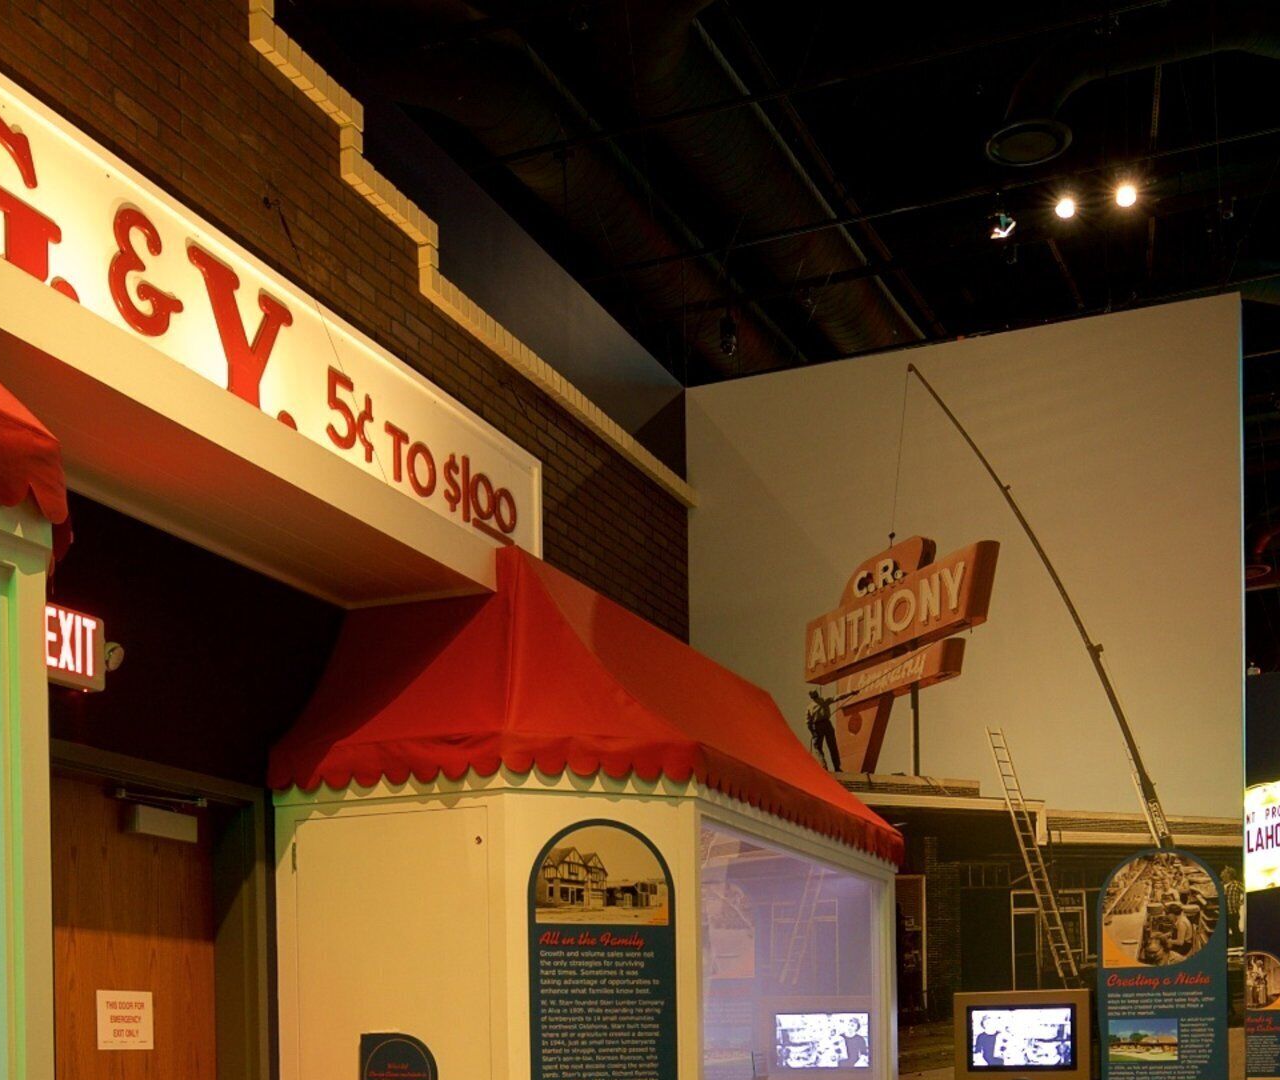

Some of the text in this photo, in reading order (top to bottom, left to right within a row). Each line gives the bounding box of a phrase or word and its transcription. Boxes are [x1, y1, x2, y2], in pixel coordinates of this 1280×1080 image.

[325, 365, 375, 463] 5¢
[384, 420, 437, 498] TO
[853, 558, 905, 598] C.R.
[808, 561, 966, 669] ANTHONY
[45, 606, 96, 677] EXIT
[539, 932, 559, 946] All
[578, 932, 597, 946] the
[600, 932, 645, 949] Family
[1107, 973, 1160, 989] Creating
[119, 1001, 134, 1009] DOOR
